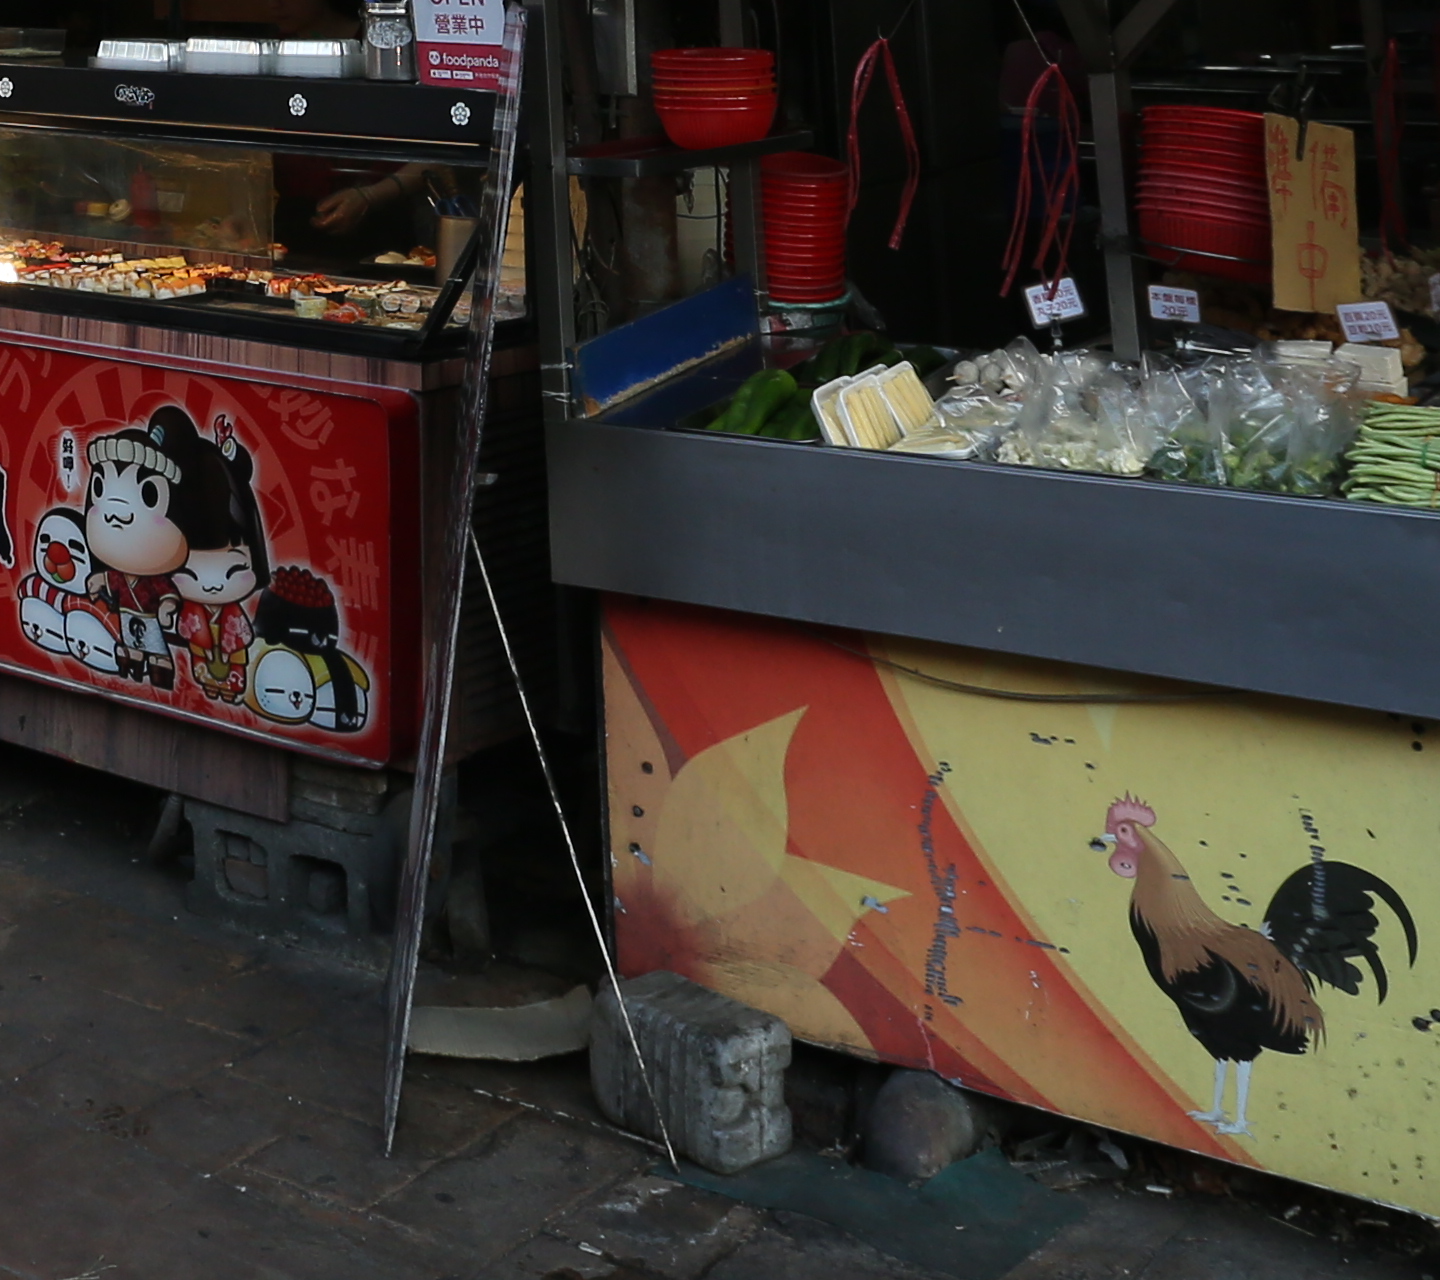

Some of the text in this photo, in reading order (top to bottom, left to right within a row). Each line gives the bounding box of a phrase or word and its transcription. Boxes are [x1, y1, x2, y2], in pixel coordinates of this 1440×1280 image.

[435, 13, 484, 35] 營業中
[442, 52, 499, 69] foodpanda
